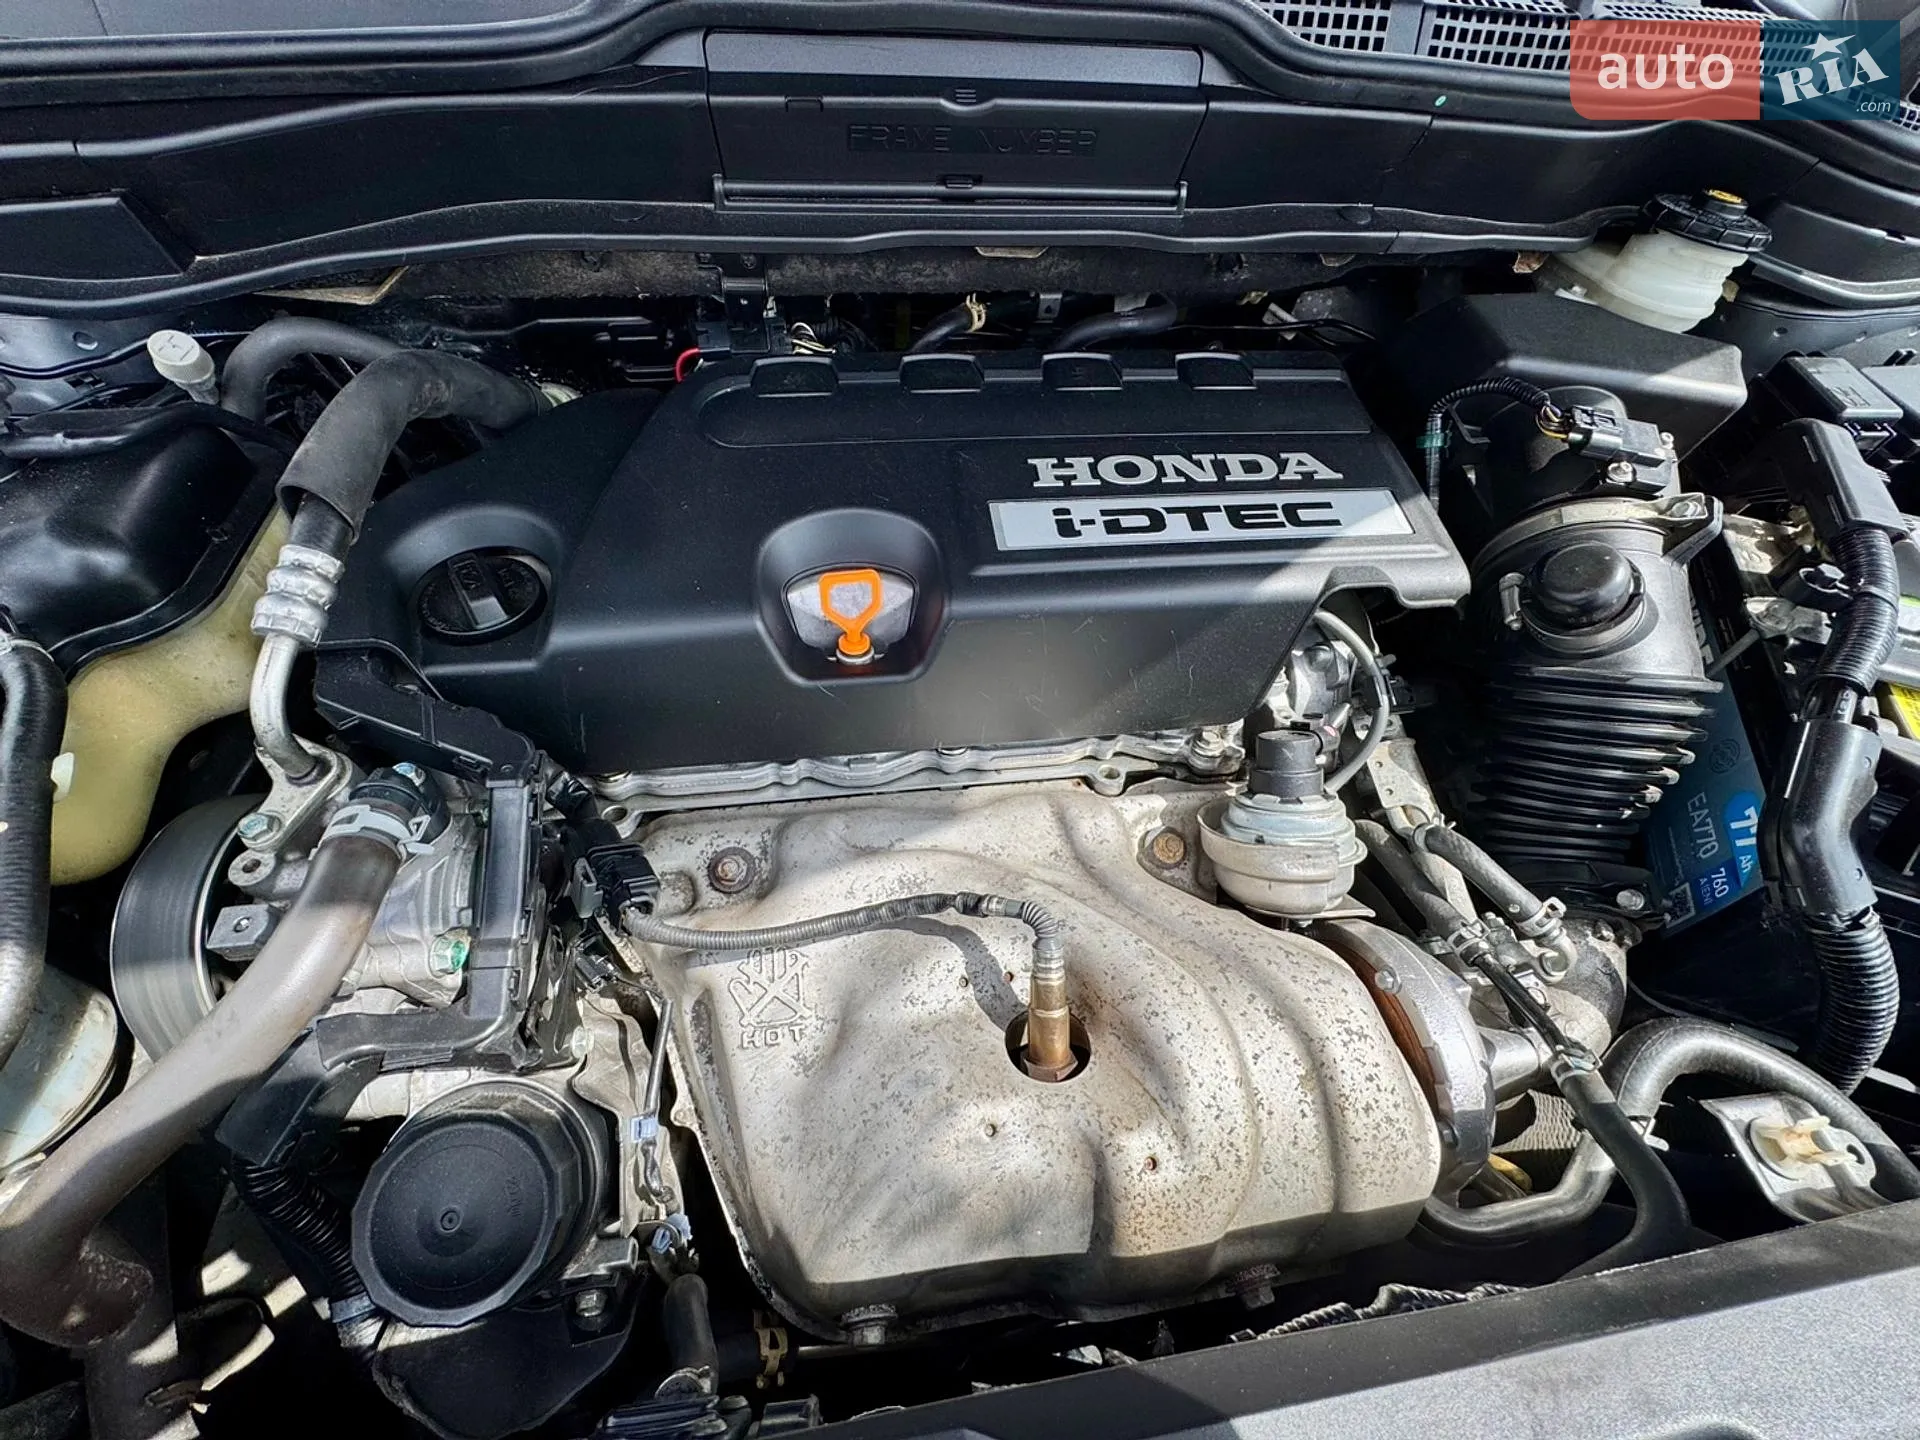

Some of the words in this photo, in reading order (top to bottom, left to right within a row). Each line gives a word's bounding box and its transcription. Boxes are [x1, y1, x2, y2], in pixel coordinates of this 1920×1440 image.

[850, 126, 951, 151] FRAME
[978, 129, 1098, 154] NUMBER
[1027, 453, 1344, 487] HONDA
[1052, 501, 1343, 539] i-DTEC
[1688, 792, 1719, 860] EA770
[1739, 855, 1755, 873] Ah
[1711, 867, 1730, 899] 760
[741, 1025, 806, 1049] HOT
